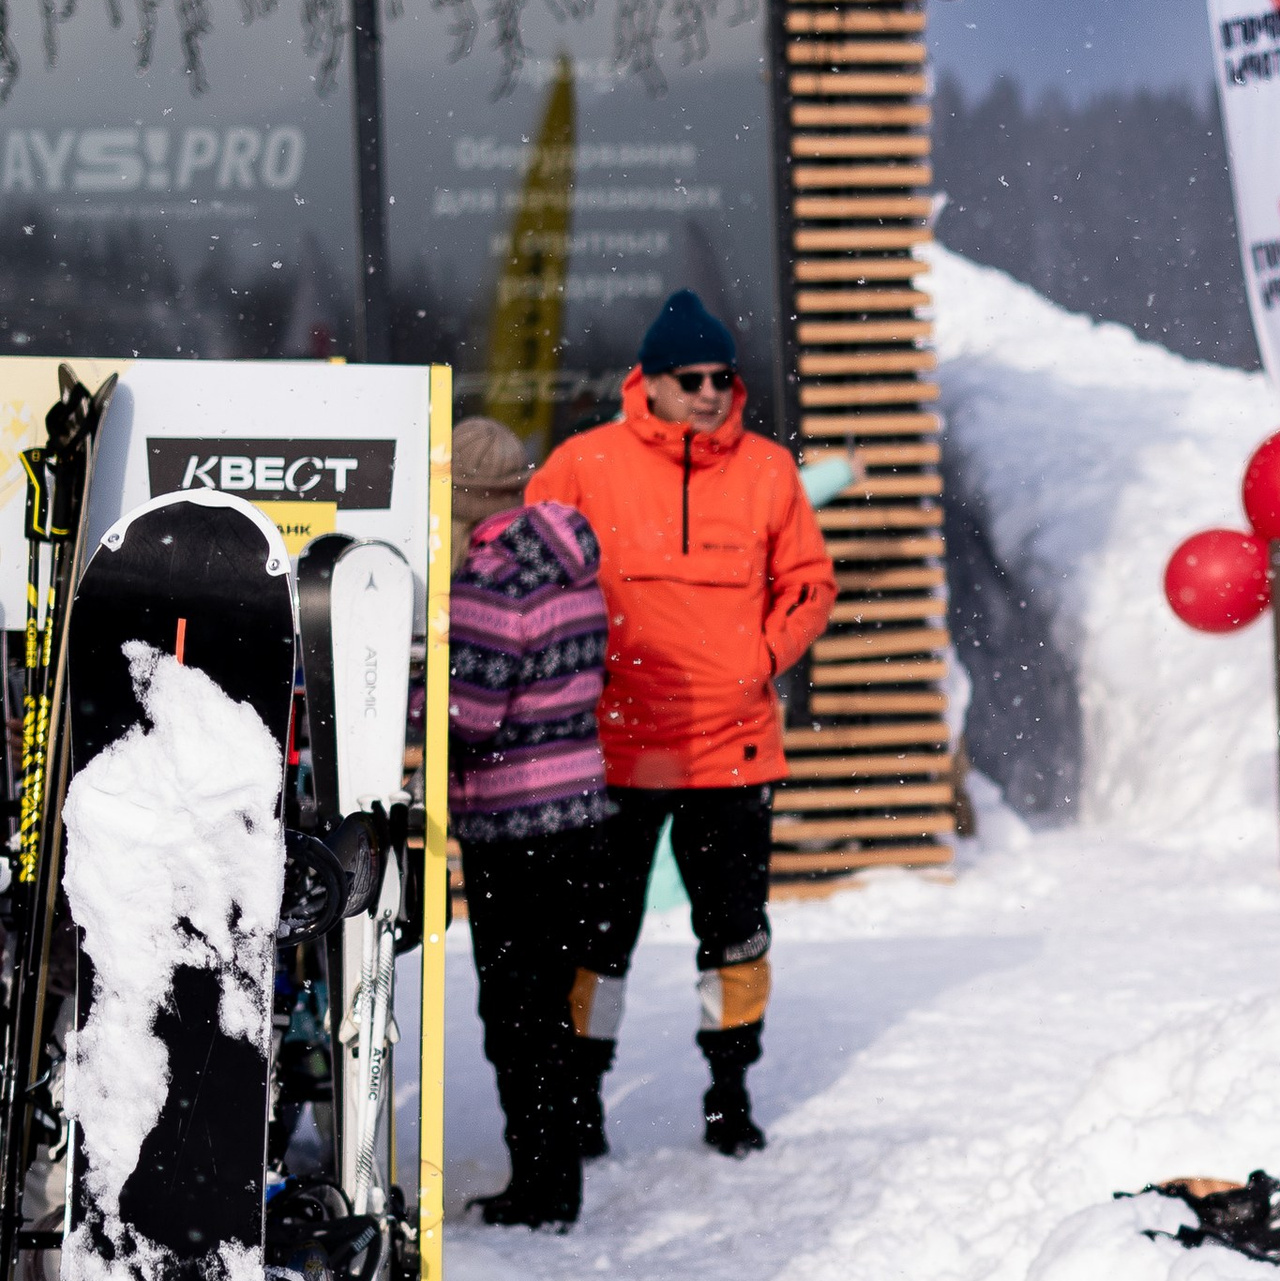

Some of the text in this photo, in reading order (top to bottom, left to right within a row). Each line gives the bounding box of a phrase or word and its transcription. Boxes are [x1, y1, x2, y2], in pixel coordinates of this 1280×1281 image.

[1, 127, 304, 192] AYS!PRO
[182, 455, 359, 493] КВЕСТ
[364, 646, 378, 719] ATOMIC
[369, 1047, 383, 1101] ATOMIC
